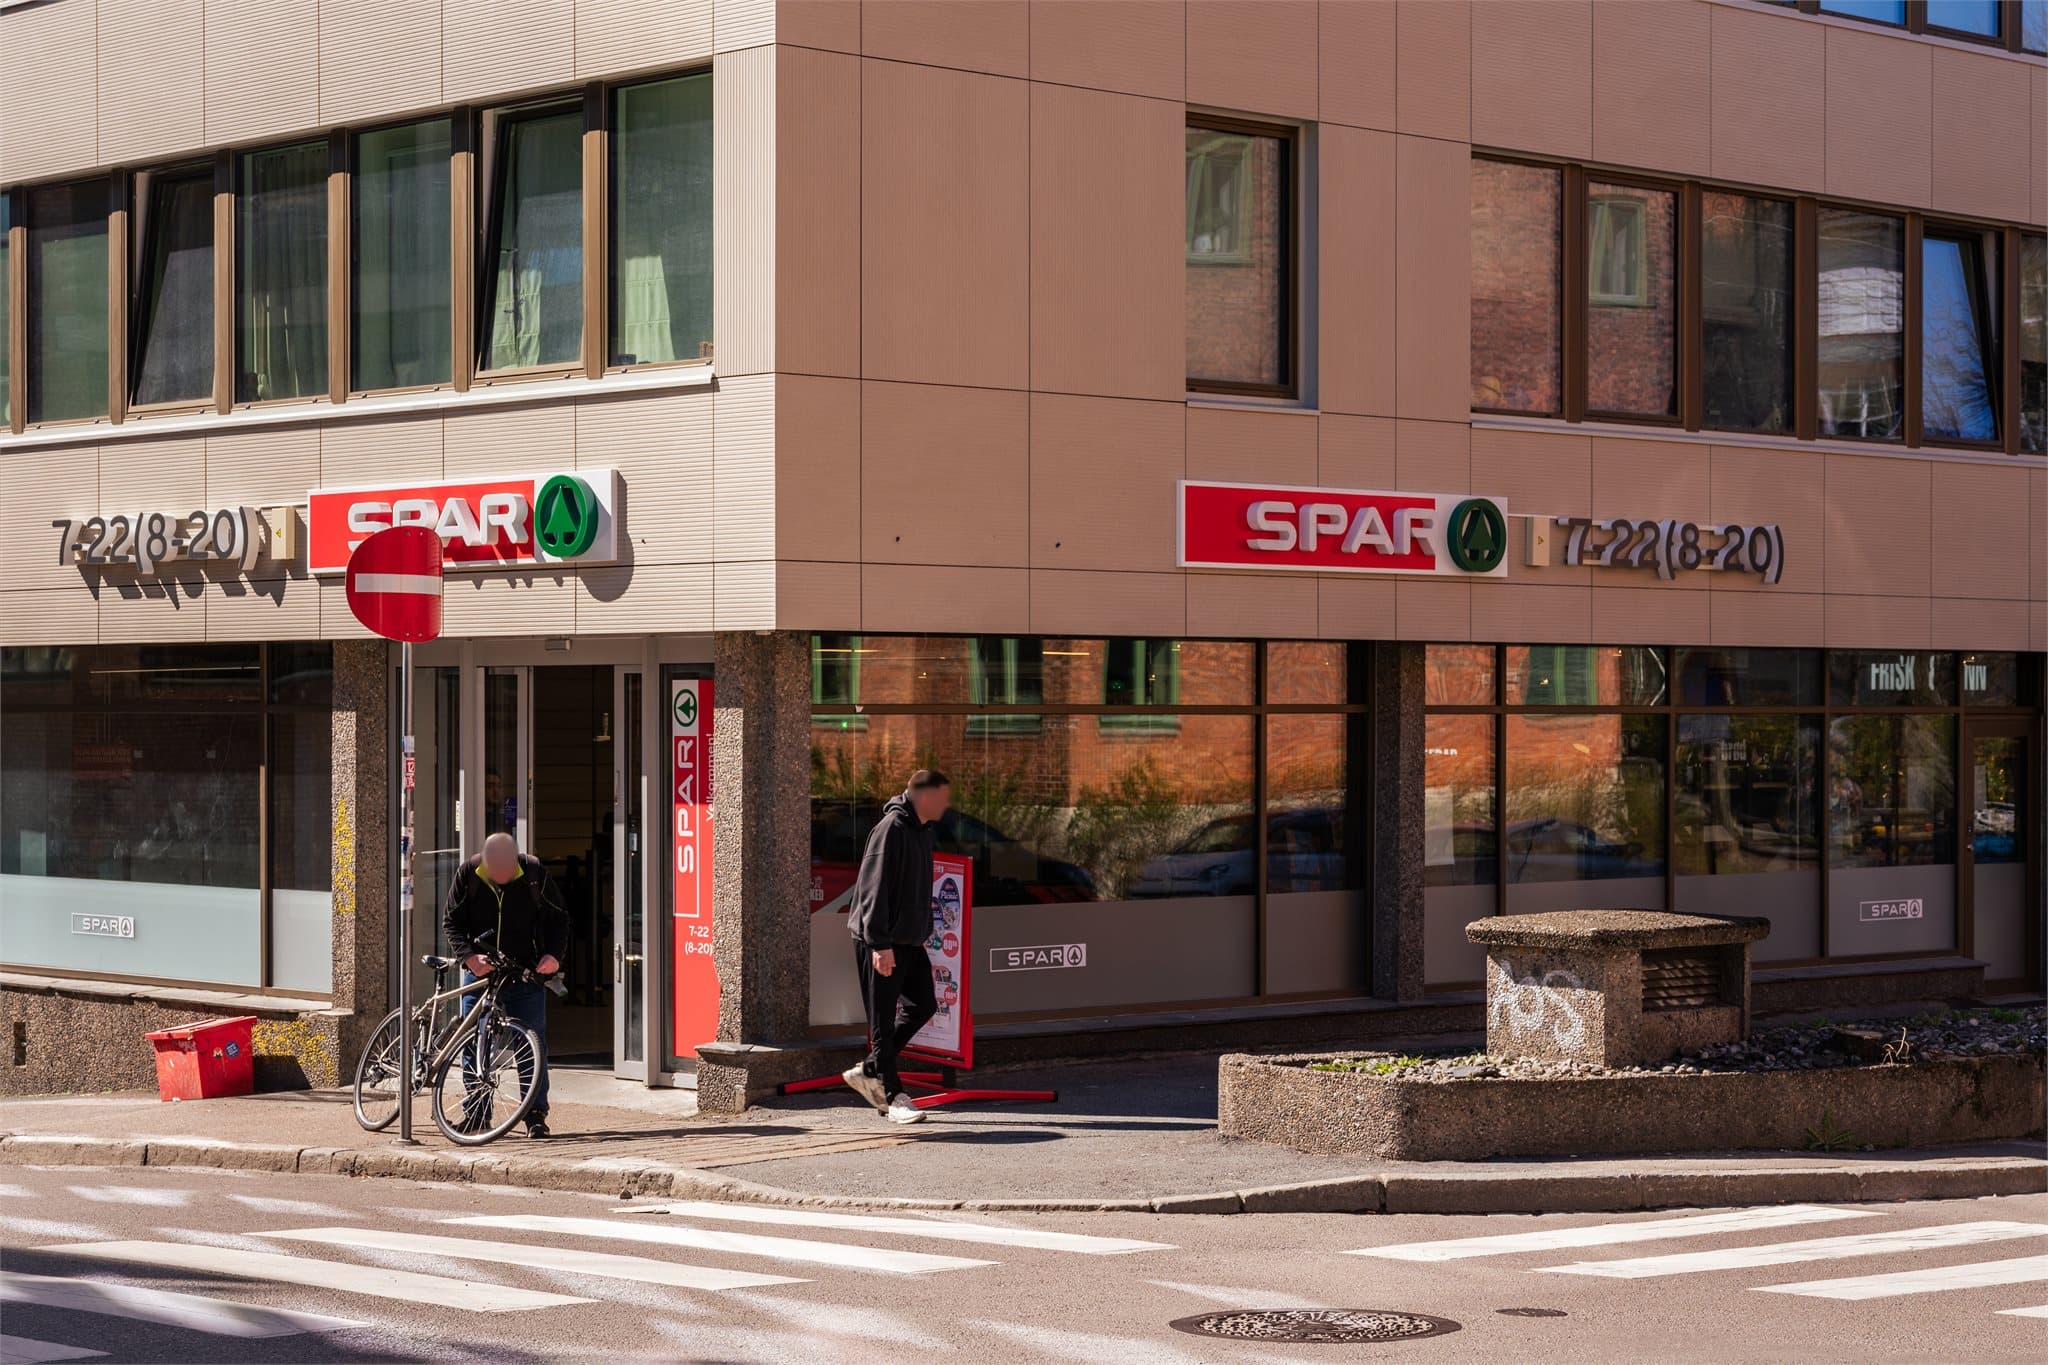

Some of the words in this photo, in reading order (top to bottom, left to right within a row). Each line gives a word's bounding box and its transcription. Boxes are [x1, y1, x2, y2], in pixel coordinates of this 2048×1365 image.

[52, 506, 259, 574] 7-22(8-20)
[348, 493, 529, 552] SPAR
[1246, 500, 1436, 558] SPAR
[1560, 516, 1785, 584] 7-22(8-20)
[678, 739, 694, 873] SPAR
[82, 917, 118, 934] SPAR
[1871, 903, 1908, 918] SPAR
[684, 937, 713, 956] (8-20)
[688, 925, 709, 938] 7-22
[1008, 950, 1063, 966] SPAR
